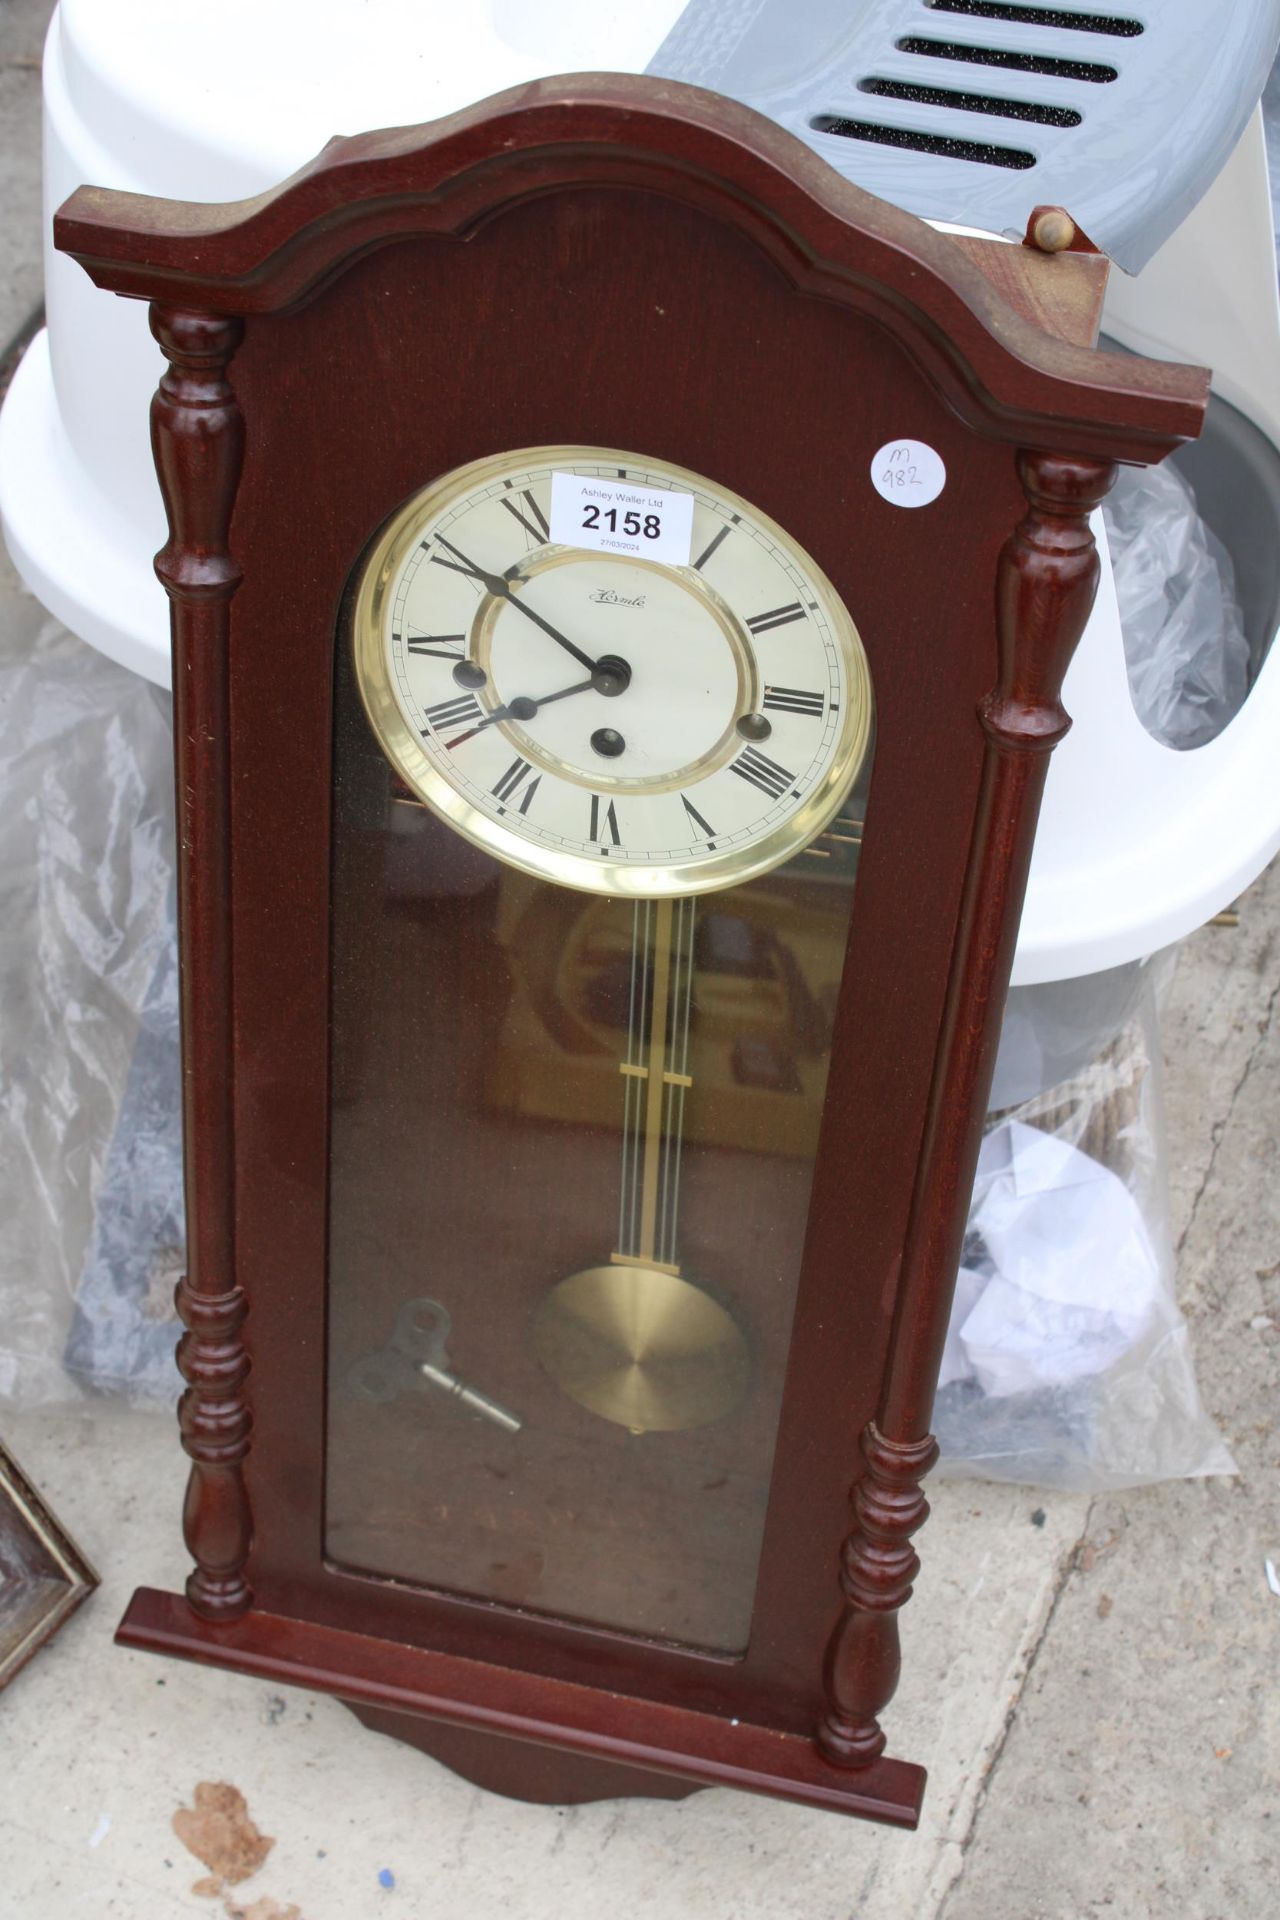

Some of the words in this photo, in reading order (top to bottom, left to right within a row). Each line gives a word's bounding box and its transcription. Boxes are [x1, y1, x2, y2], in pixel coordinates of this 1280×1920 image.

[882, 466, 922, 488] 982
[581, 487, 613, 502] Ashley
[616, 493, 646, 505] Waller
[648, 498, 663, 508] Ltd
[581, 504, 661, 540] 2158
[600, 538, 640, 551] 27/03/2024
[588, 588, 647, 608] Hermle
[743, 597, 809, 639] II
[762, 681, 824, 722] III
[583, 793, 625, 847] VI
